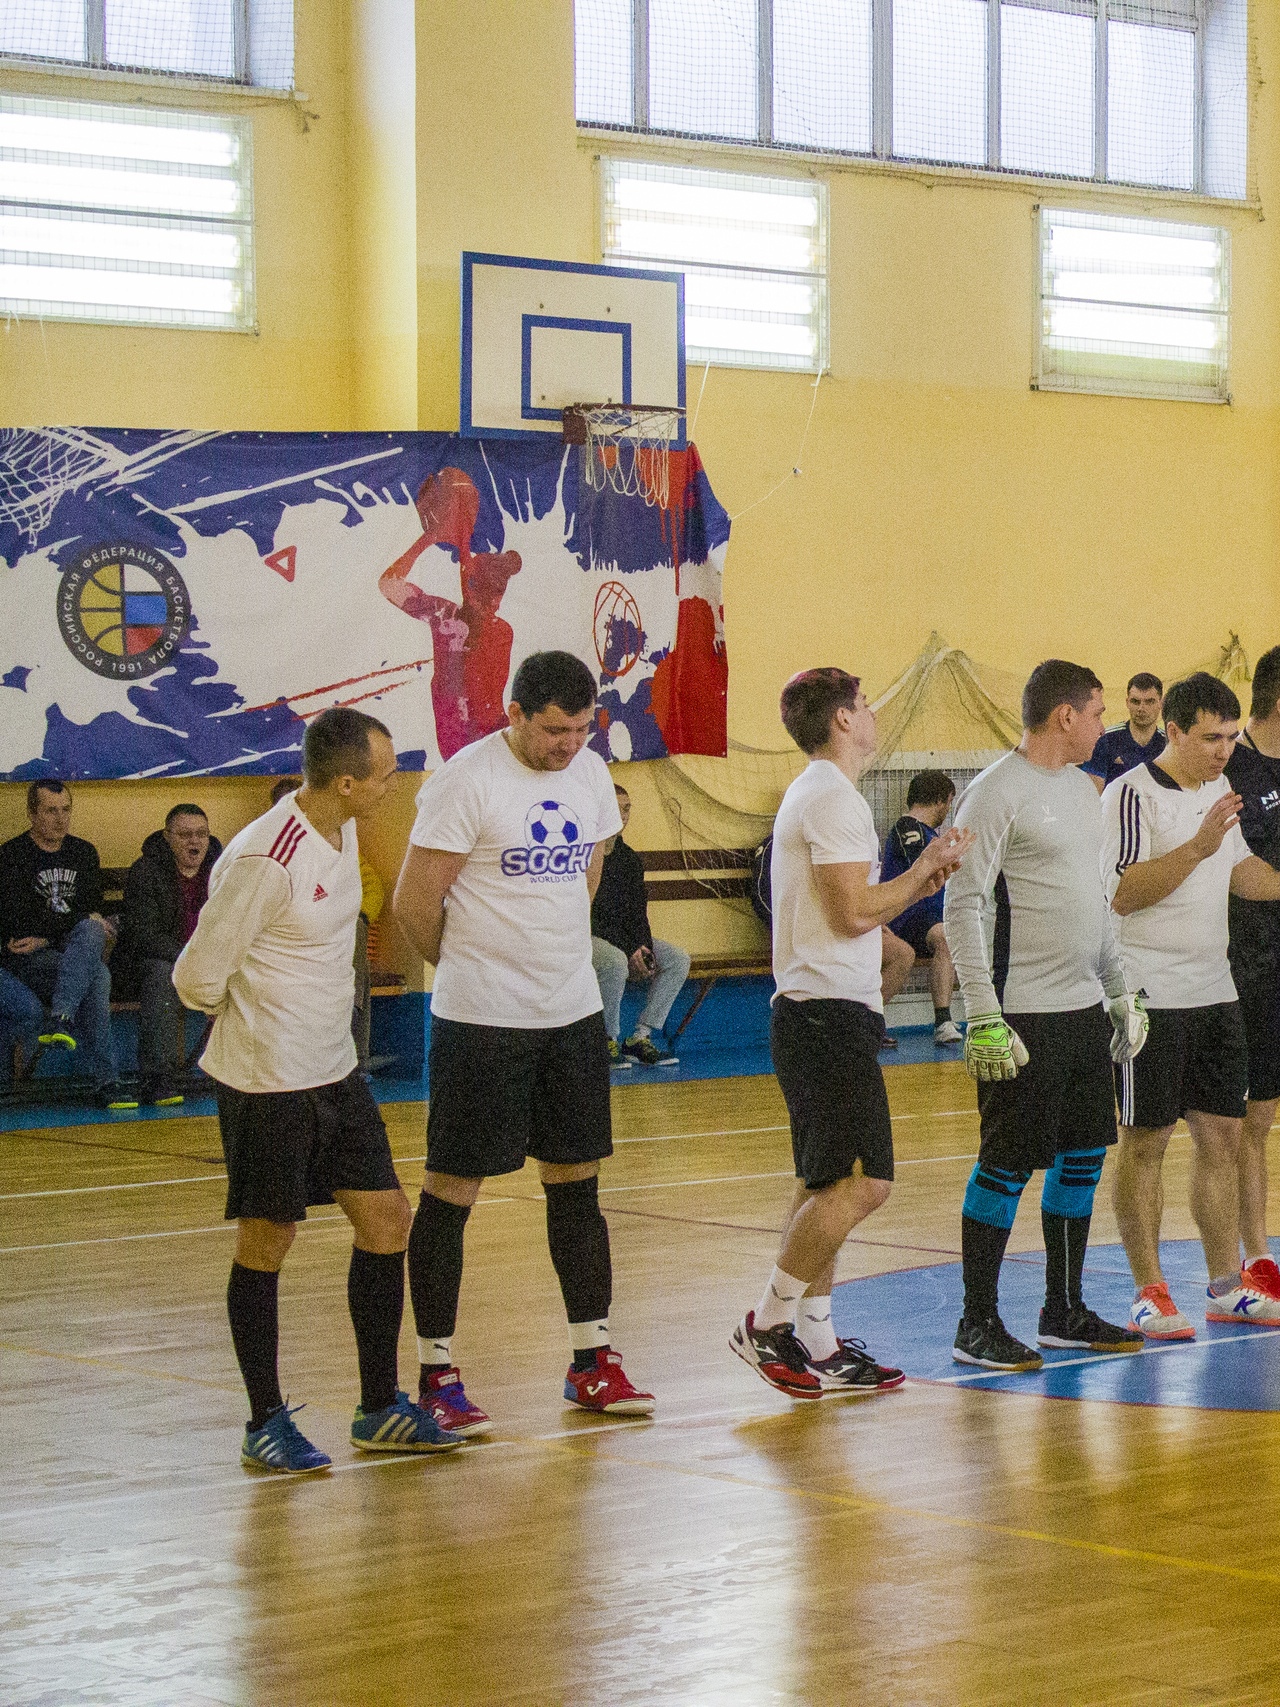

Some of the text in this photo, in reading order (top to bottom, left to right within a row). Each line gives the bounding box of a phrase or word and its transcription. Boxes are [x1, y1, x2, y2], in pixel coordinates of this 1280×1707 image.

[64, 546, 184, 667] РОССИЙСКАЯ ФЕДЕРАЦИЯ БАСКЕТБОЛА
[501, 842, 596, 876] SOCH
[529, 874, 578, 884] WORLD CUP
